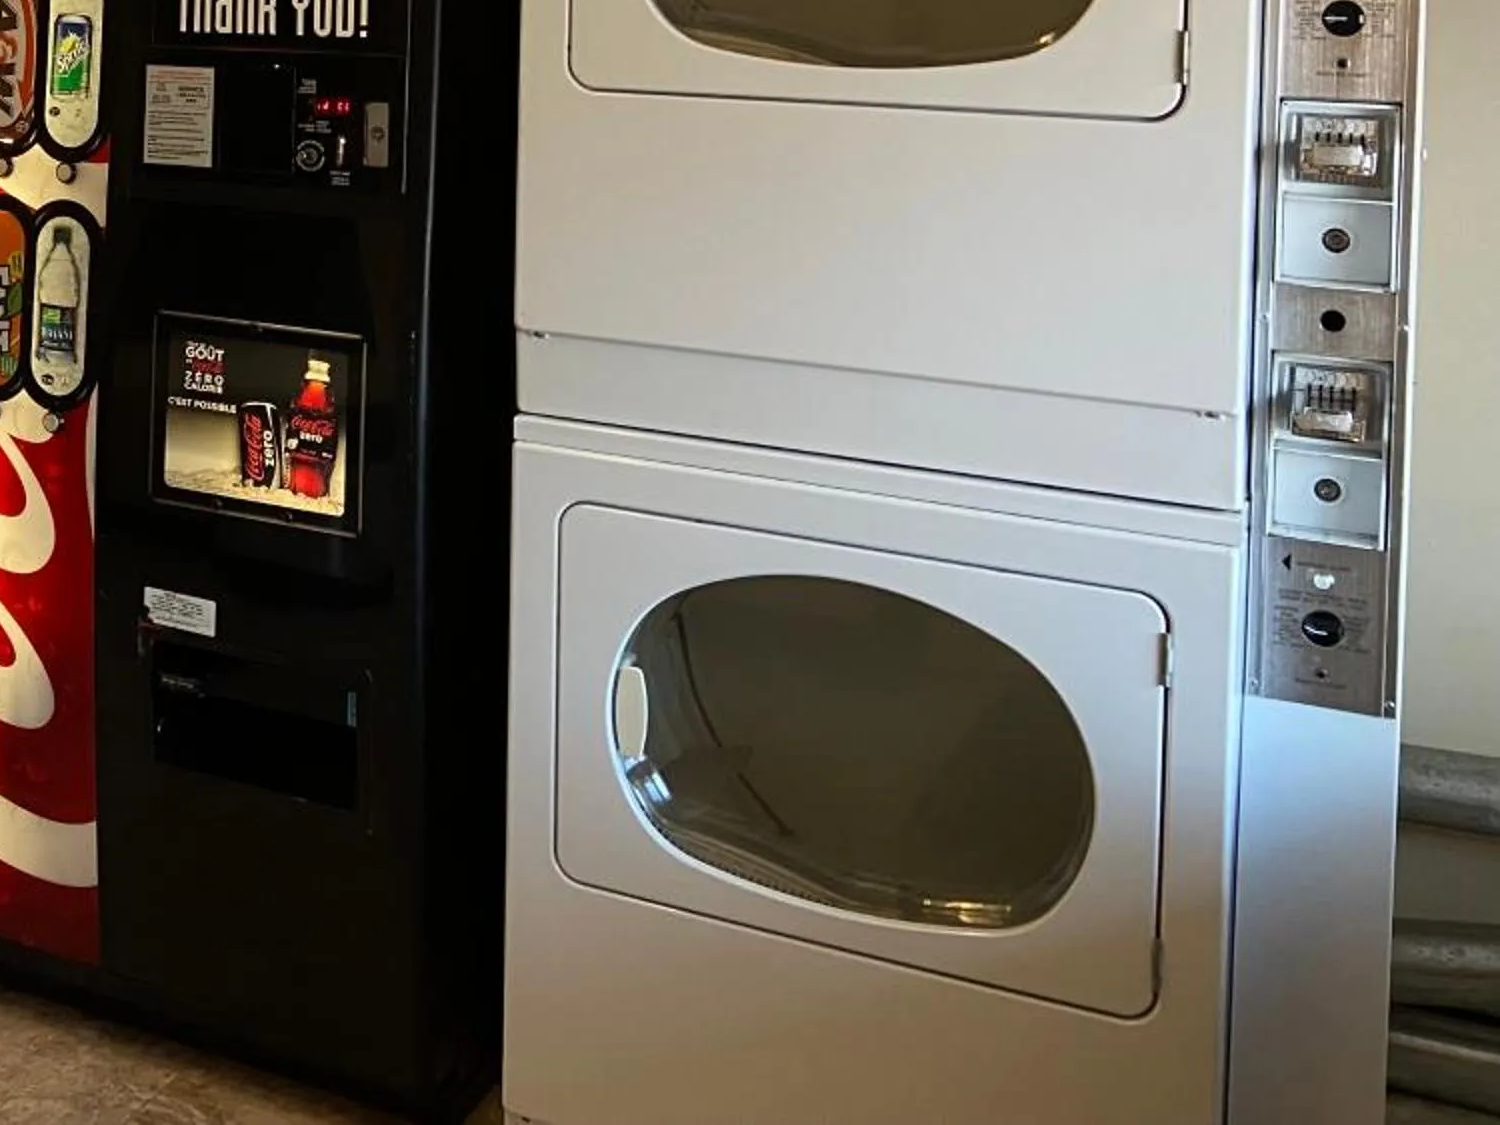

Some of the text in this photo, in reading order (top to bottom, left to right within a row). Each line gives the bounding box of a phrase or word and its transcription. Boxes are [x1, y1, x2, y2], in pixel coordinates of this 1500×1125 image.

[56, 40, 90, 74] Sprite
[185, 344, 225, 362] GOÛT
[185, 370, 225, 386] ZERO
[299, 430, 323, 444] zero
[263, 430, 275, 467] zero
